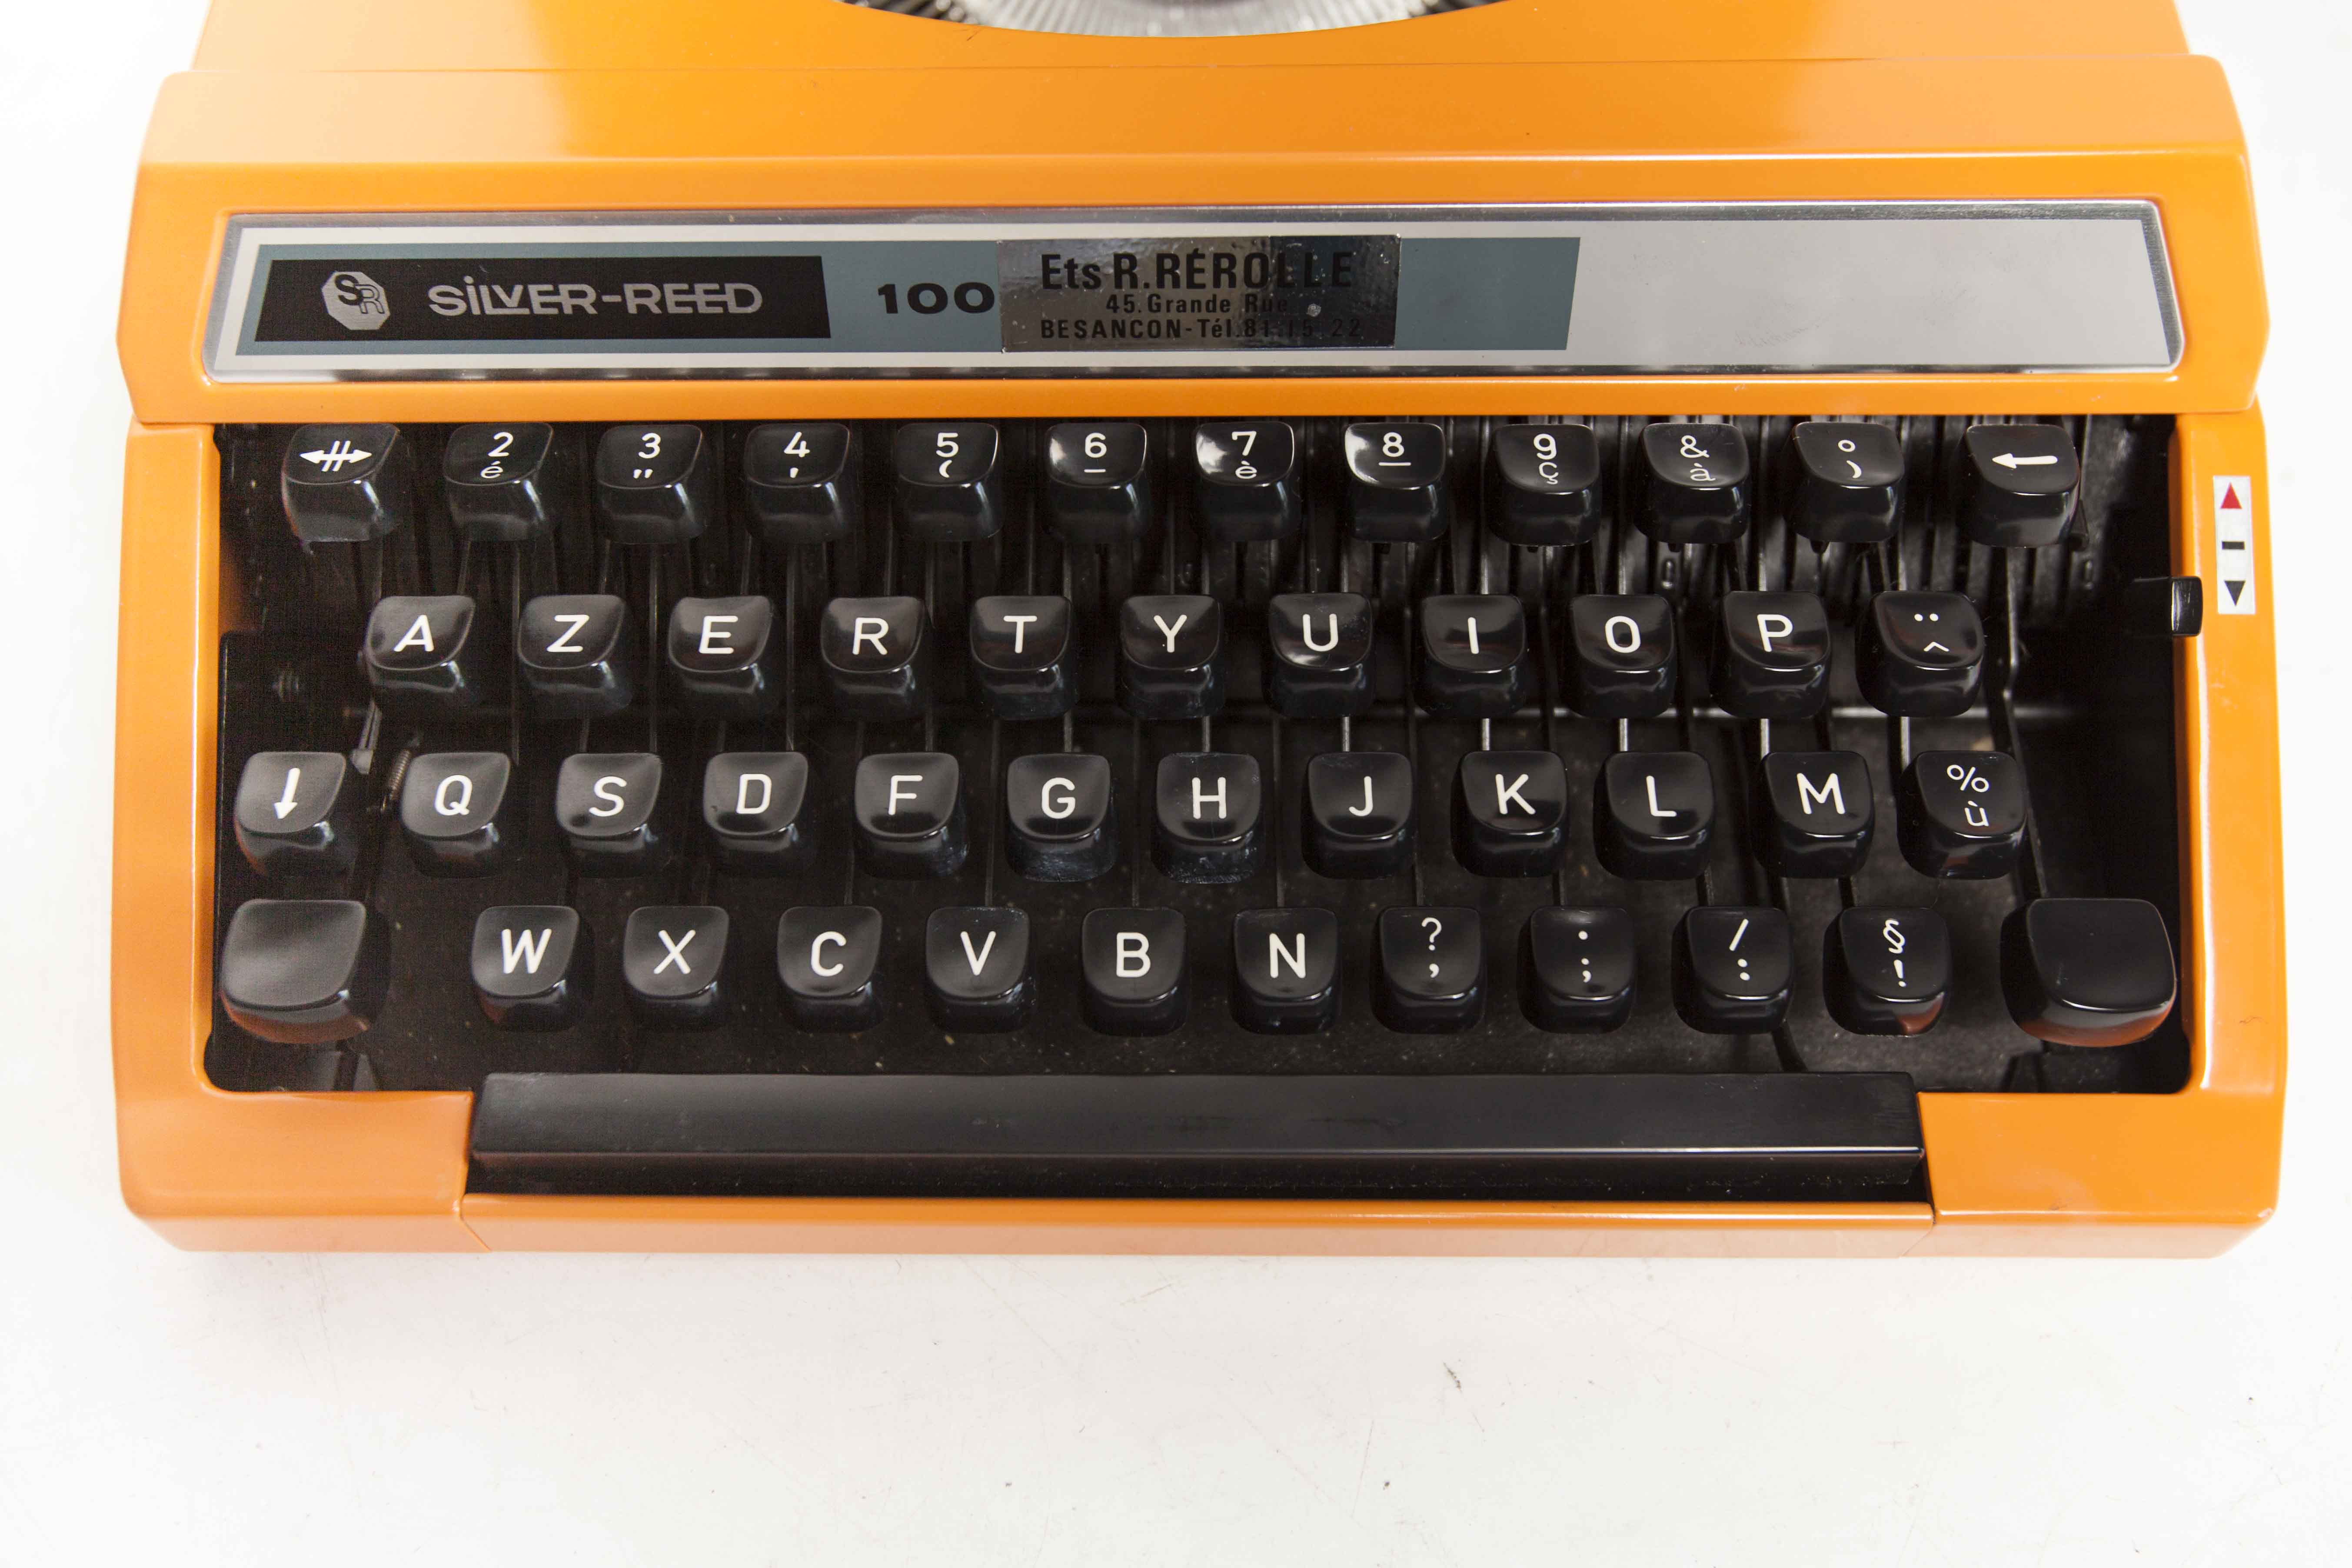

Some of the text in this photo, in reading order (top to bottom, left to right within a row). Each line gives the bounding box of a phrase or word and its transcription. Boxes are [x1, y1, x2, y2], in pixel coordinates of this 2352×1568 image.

[1041, 254, 1101, 290] Ets
[877, 283, 995, 314] 100
[1245, 293, 1288, 313] Rue
[488, 432, 513, 457] 2
[638, 433, 661, 459] 3
[784, 432, 810, 457] 4
[936, 433, 959, 457] 5
[1085, 433, 1107, 458] 6
[1232, 431, 1257, 456] 7
[1383, 432, 1404, 457] 8
[1534, 433, 1557, 460] 9
[1680, 435, 1710, 458] &
[481, 461, 503, 479] é
[1235, 460, 1257, 479] è
[1539, 462, 1559, 485] ç
[1690, 463, 1716, 481] à
[393, 614, 434, 652] A
[547, 614, 590, 653] Z
[699, 615, 739, 654] E
[852, 617, 889, 655] R
[1003, 615, 1038, 653] T
[1154, 614, 1187, 653] Y
[1303, 613, 1338, 652] U
[1467, 617, 1479, 654] I
[1605, 616, 1640, 653] O
[1757, 614, 1793, 652] P
[434, 775, 473, 816] Q
[589, 776, 627, 817] S
[736, 773, 772, 814] D
[888, 775, 923, 816] F
[1349, 776, 1373, 816] J
[1495, 774, 1535, 814] K
[1646, 776, 1677, 817] L
[1797, 773, 1845, 815] M
[1946, 765, 1989, 792] %
[1041, 777, 1076, 819] G
[1192, 777, 1227, 819] H
[1964, 800, 1989, 826] ù
[502, 928, 552, 974] W
[653, 930, 696, 974] X
[1422, 917, 1441, 951] ?
[1729, 919, 1749, 951] /
[1883, 919, 1905, 954] §
[811, 931, 846, 977] C
[960, 931, 996, 975] V
[1116, 932, 1151, 978] B
[1269, 933, 1306, 979] N
[1894, 959, 1906, 987] !
